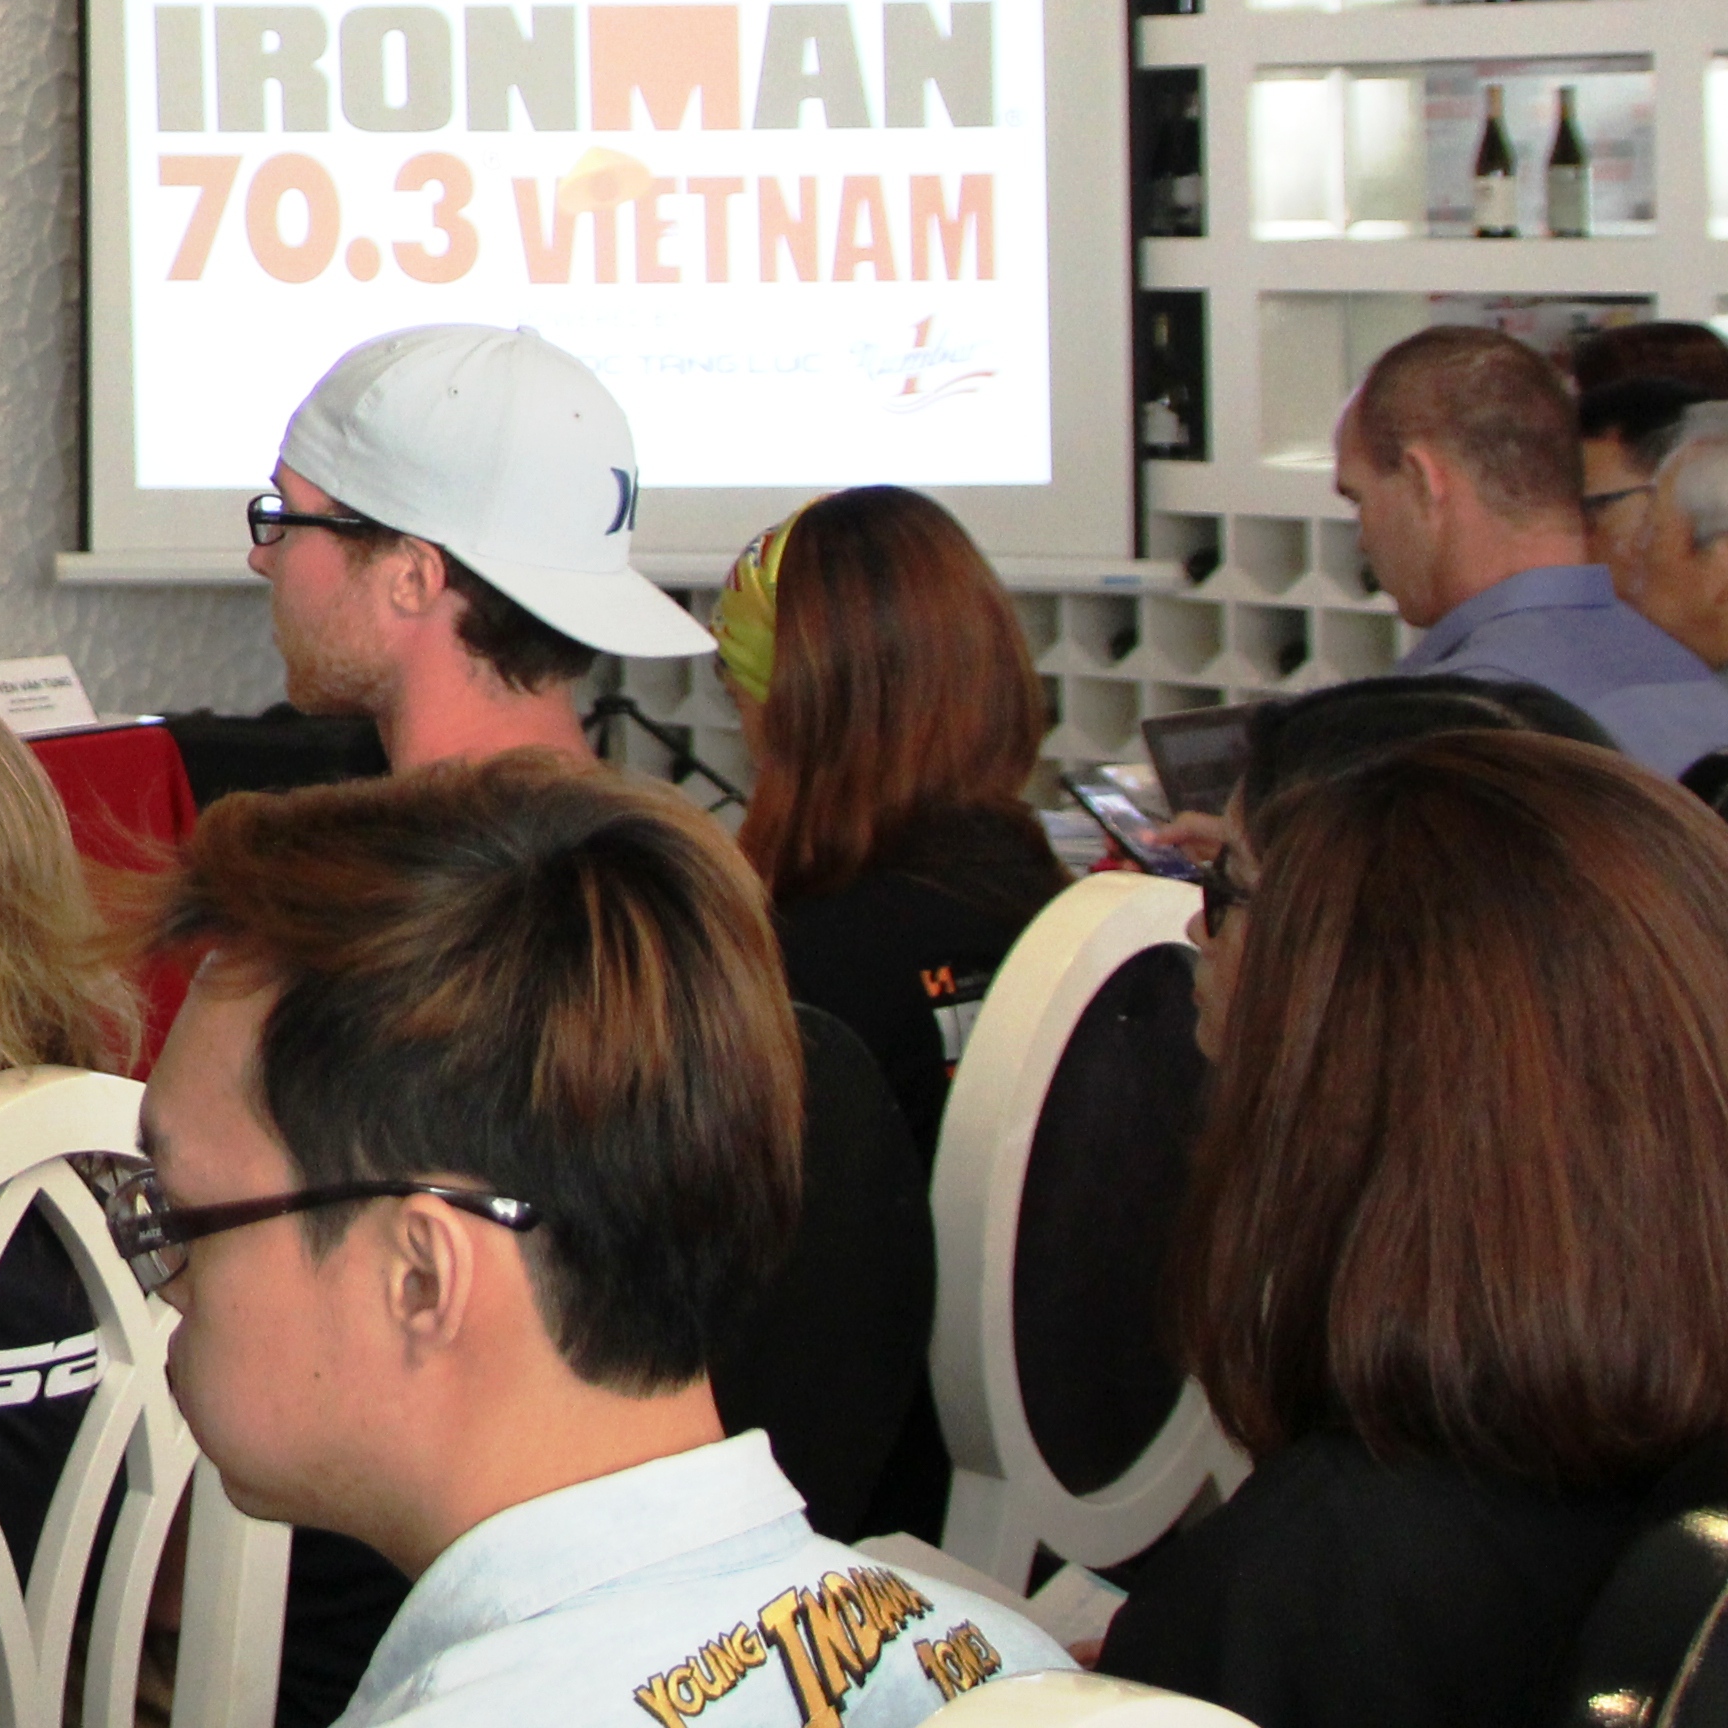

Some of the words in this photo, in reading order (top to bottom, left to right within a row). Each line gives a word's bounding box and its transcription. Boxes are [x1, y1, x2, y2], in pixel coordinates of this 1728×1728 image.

[153, 0, 996, 133] IRONMAN
[157, 152, 479, 285] 70.3
[510, 172, 996, 285] VIETNAM
[633, 1621, 767, 1728] YOUNG
